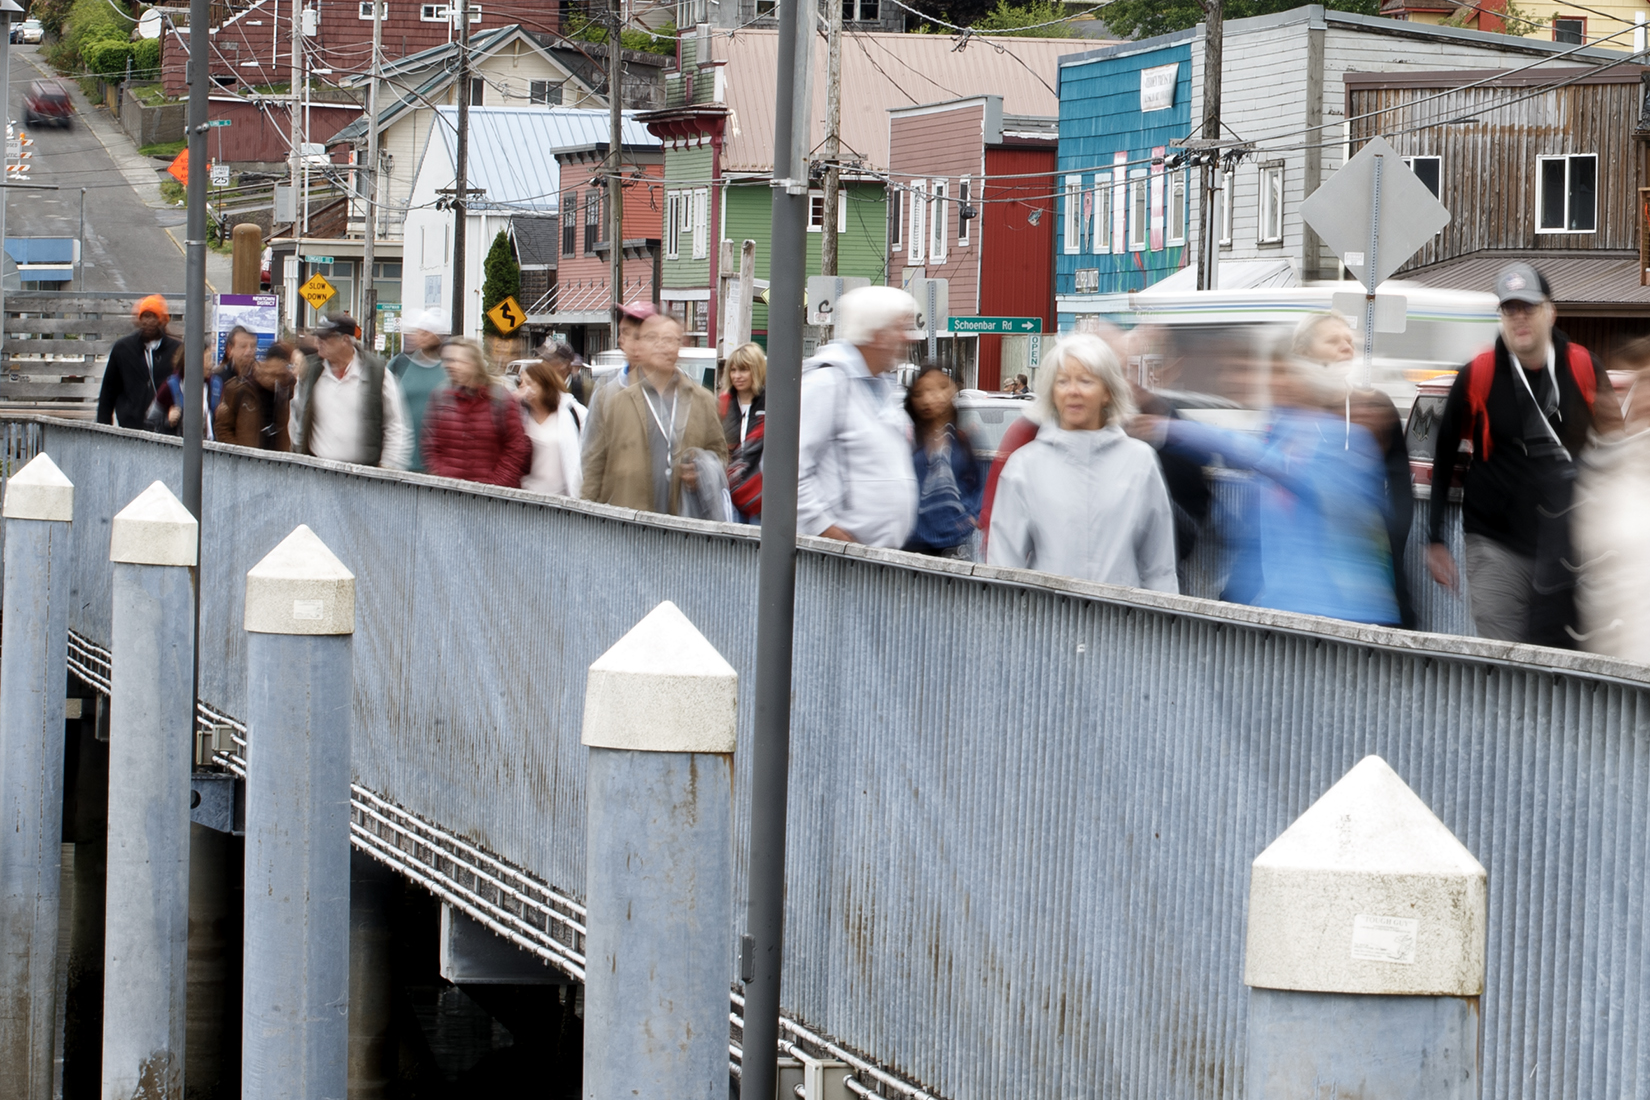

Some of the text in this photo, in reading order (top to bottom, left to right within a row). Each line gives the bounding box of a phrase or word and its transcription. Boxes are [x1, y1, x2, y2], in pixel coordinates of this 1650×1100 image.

[213, 176, 228, 184] 25
[308, 282, 326, 290] SLOW
[307, 293, 327, 301] DOWN
[953, 319, 1013, 331] Schoenbar Rd
[1030, 336, 1039, 365] OPEN
